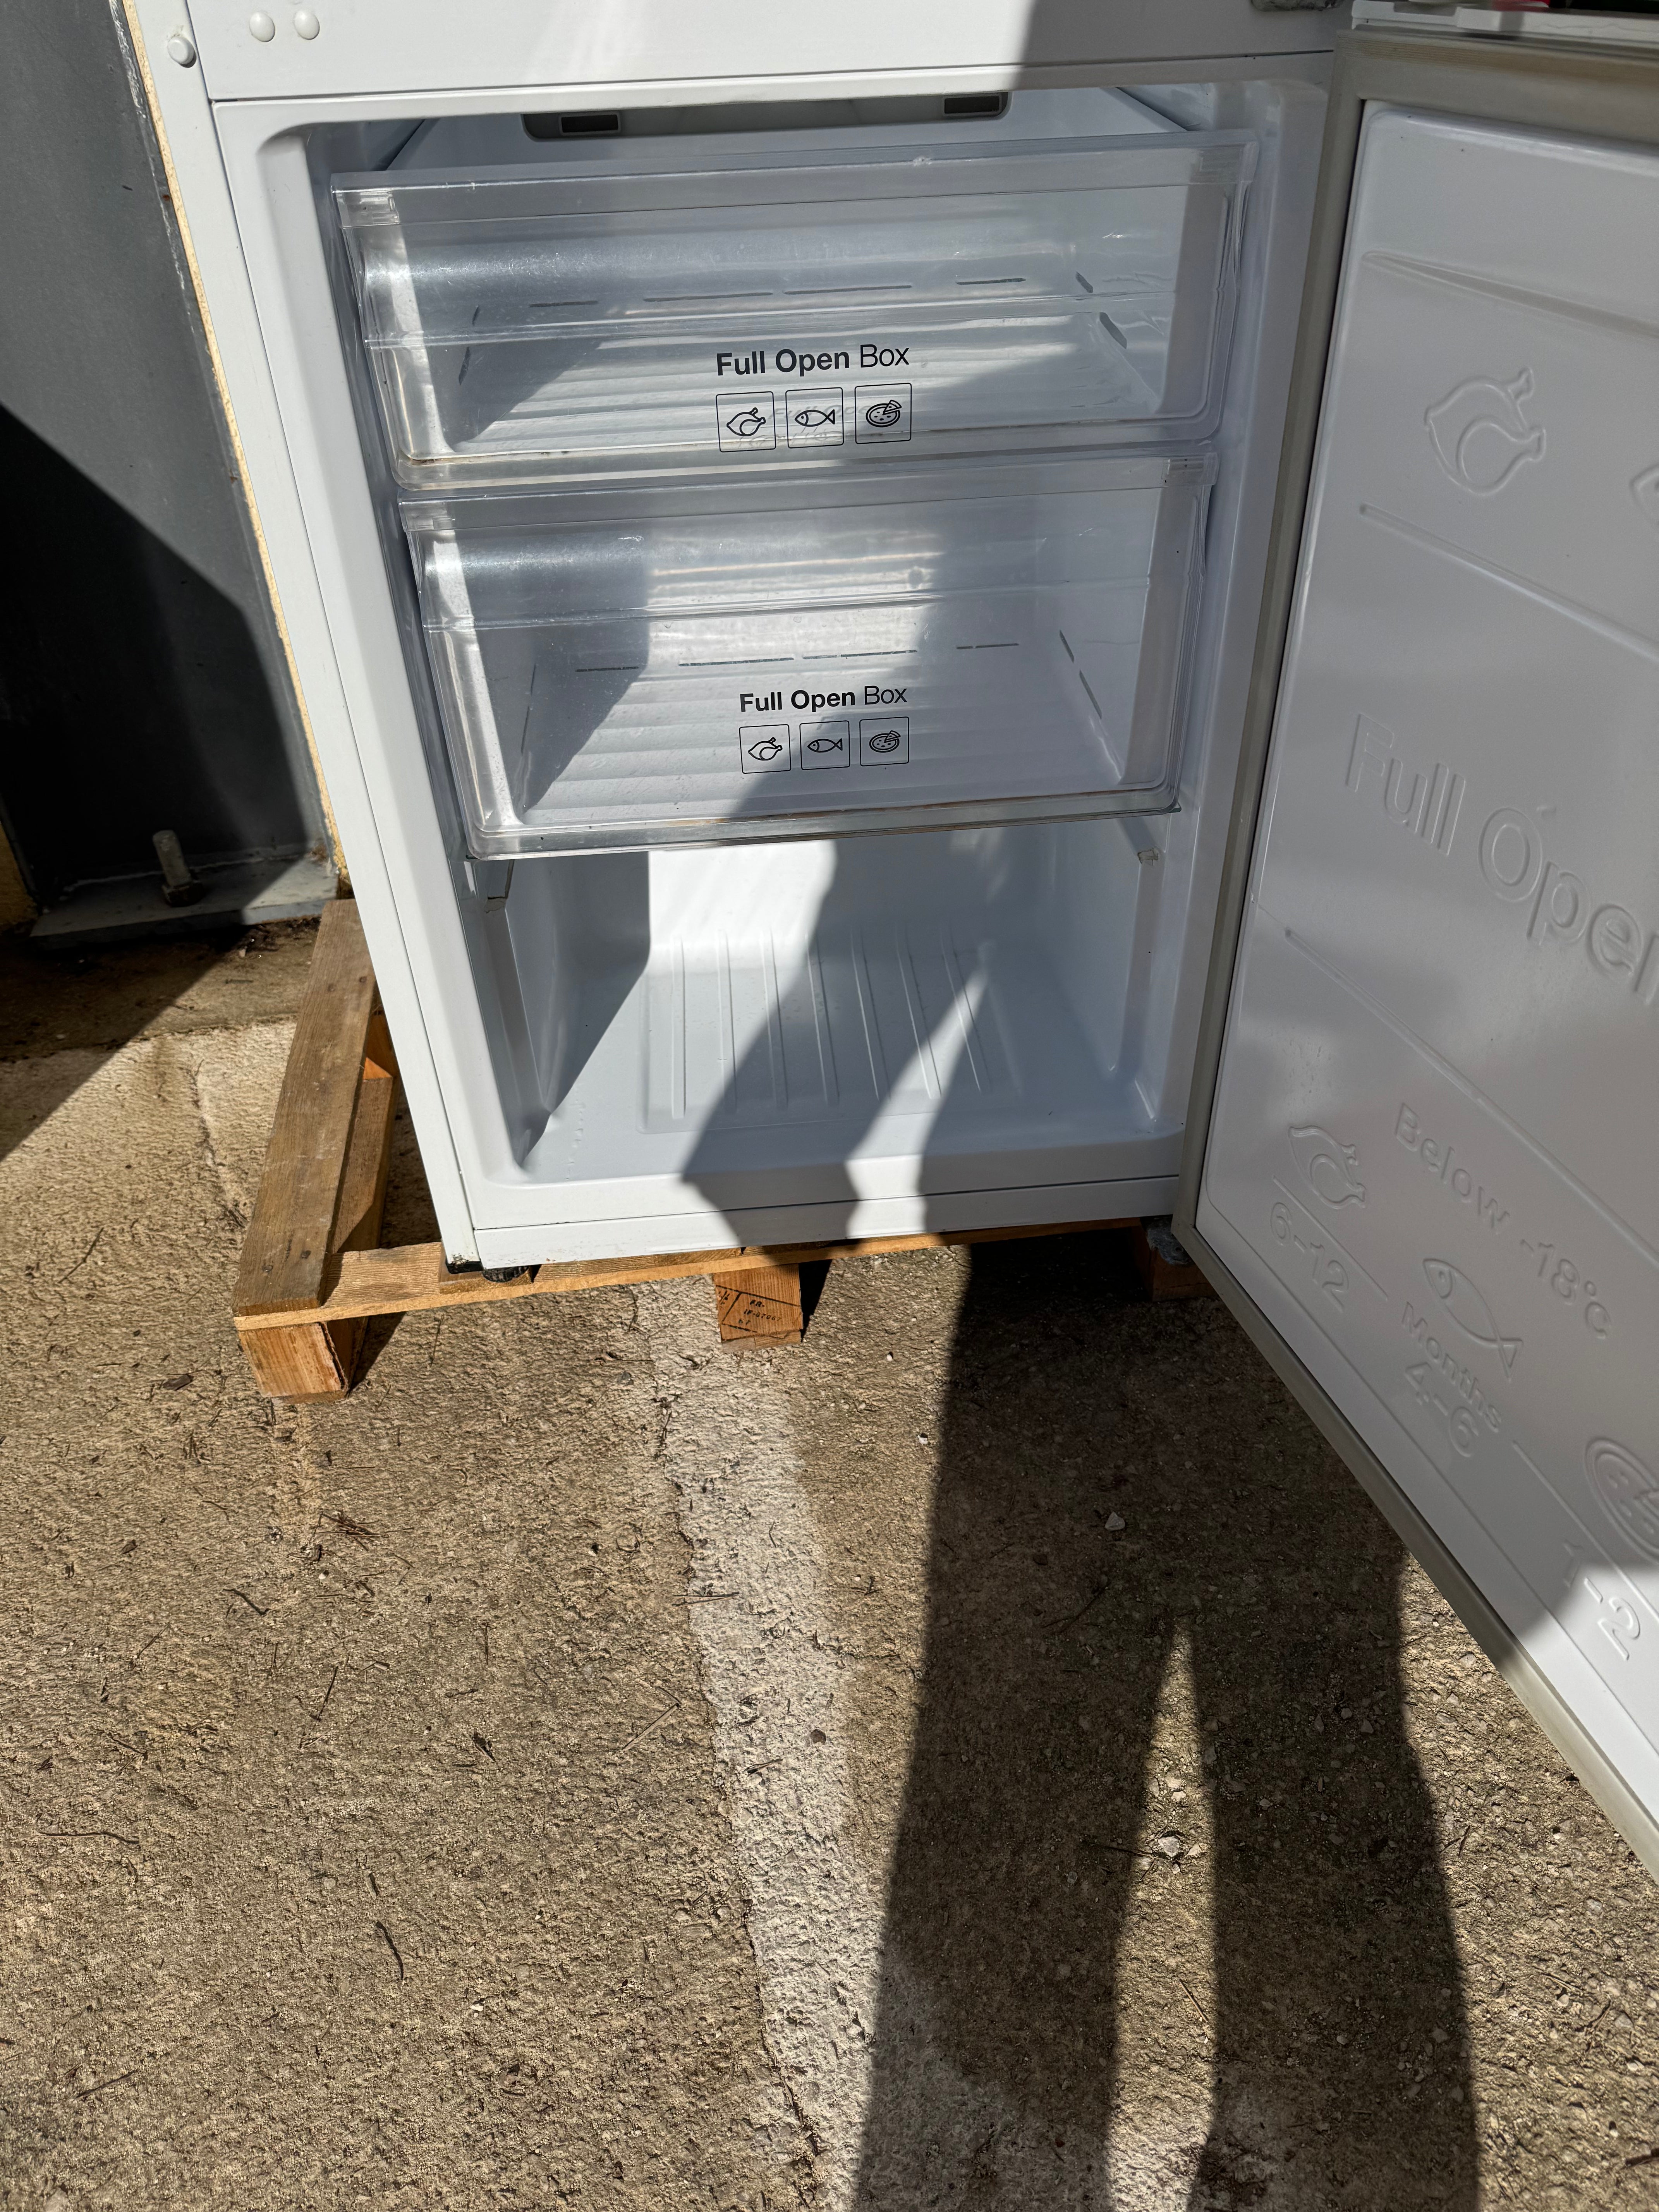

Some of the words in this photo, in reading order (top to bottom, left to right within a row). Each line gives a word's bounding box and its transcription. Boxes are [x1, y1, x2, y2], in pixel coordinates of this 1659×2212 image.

[717, 350, 765, 376] Full
[775, 349, 849, 376] Open
[860, 344, 909, 368] Box
[740, 692, 782, 712] Full
[791, 690, 855, 713] Open
[864, 685, 907, 705] Box
[1345, 713, 1466, 857] Full
[1393, 1103, 1511, 1234] Below
[1270, 1202, 1350, 1313] 6-12
[1401, 1301, 1501, 1433] Months
[1405, 1362, 1479, 1458] 4-6
